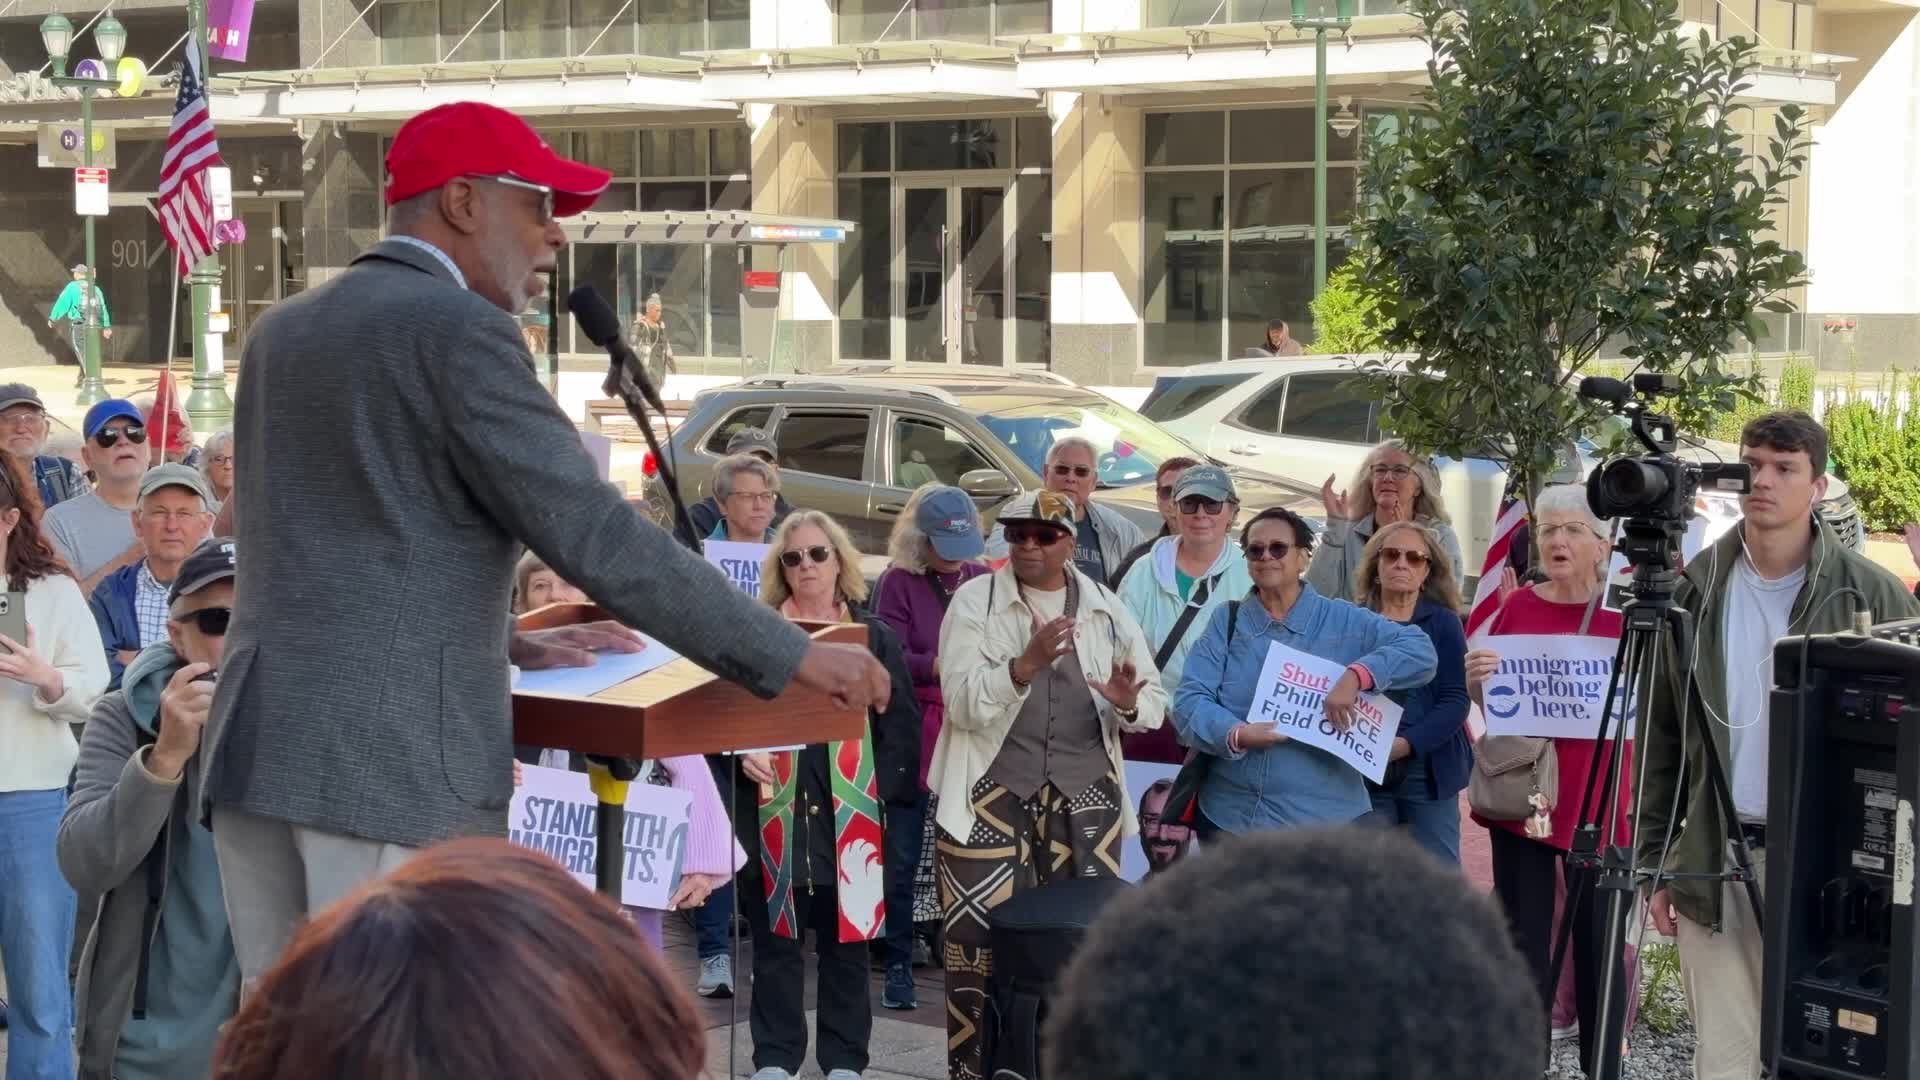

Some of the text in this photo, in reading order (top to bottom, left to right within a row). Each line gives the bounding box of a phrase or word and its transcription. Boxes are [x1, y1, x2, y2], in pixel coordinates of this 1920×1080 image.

[112, 239, 147, 268] 901
[720, 558, 761, 581] STAN
[1280, 662, 1329, 690] Shut
[1494, 653, 1617, 681] mmigran
[1518, 674, 1602, 705] belong
[1261, 699, 1314, 729] Field
[1533, 696, 1590, 719] here.
[1357, 717, 1380, 745] CE
[522, 795, 667, 849] STAND ITH
